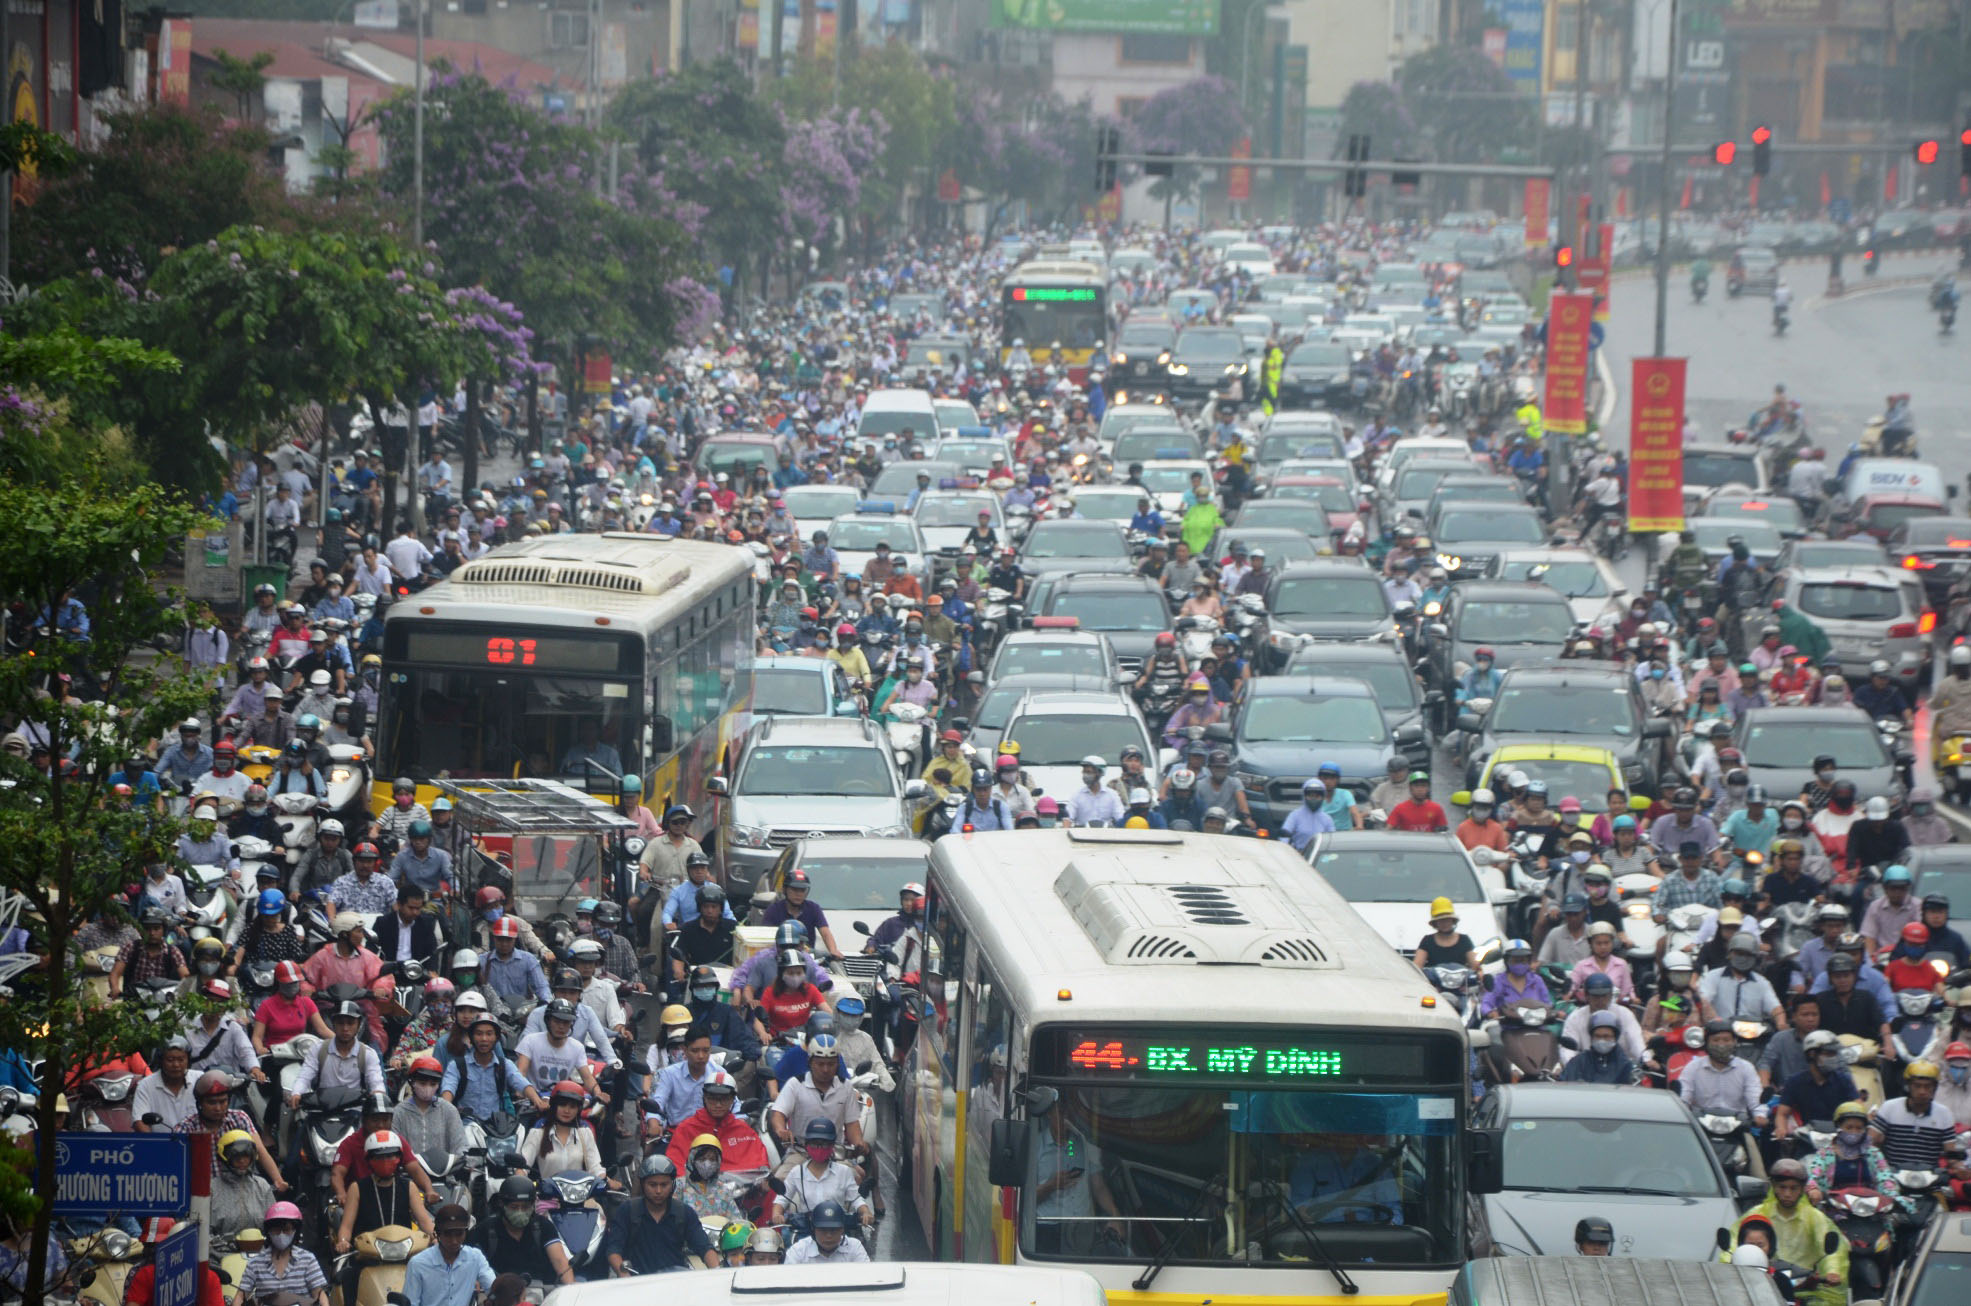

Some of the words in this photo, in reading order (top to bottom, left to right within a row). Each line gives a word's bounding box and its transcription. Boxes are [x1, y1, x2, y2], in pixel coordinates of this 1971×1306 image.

[1687, 41, 1724, 69] LED
[487, 637, 537, 665] 01
[90, 1143, 135, 1165] PHỐ
[55, 1171, 111, 1202] HƯƠNG
[116, 1172, 178, 1208] THƯỢNG
[170, 1241, 184, 1268] PHỐ
[160, 1275, 175, 1306] TÂY
[175, 1267, 193, 1302] SƠN
